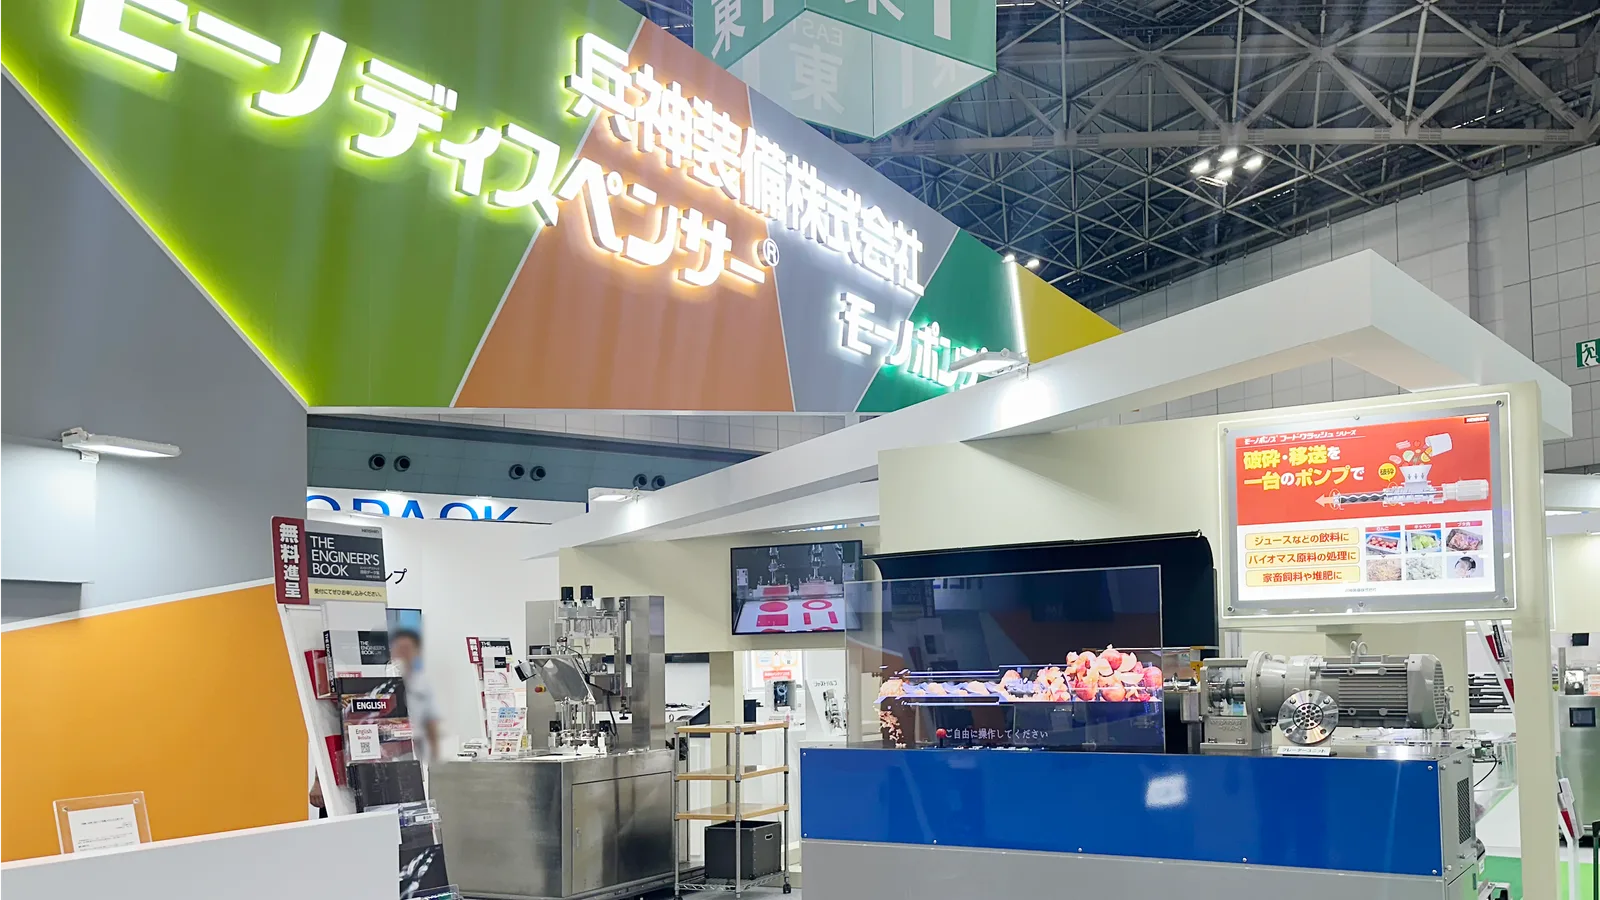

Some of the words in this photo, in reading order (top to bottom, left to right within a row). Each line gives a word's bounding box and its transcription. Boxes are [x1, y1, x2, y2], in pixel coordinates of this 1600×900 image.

[565, 32, 925, 297] 兵神装備株式会社
[1243, 444, 1341, 470] 破砕・移送を
[1243, 464, 1365, 491] 一台のポンプで
[309, 535, 336, 549] THE
[1254, 532, 1350, 547] ジュースなどの飲料に
[279, 523, 302, 598] 無料進呈
[311, 549, 380, 566] ENGINEER'S
[1248, 551, 1357, 565] バイオマス原料の処理に
[312, 563, 349, 577] BOOK
[1262, 570, 1343, 583] 家畜飼料や堆肥に
[356, 701, 387, 710] ENGLISH
[945, 728, 1049, 740] ご自由に操作してください
